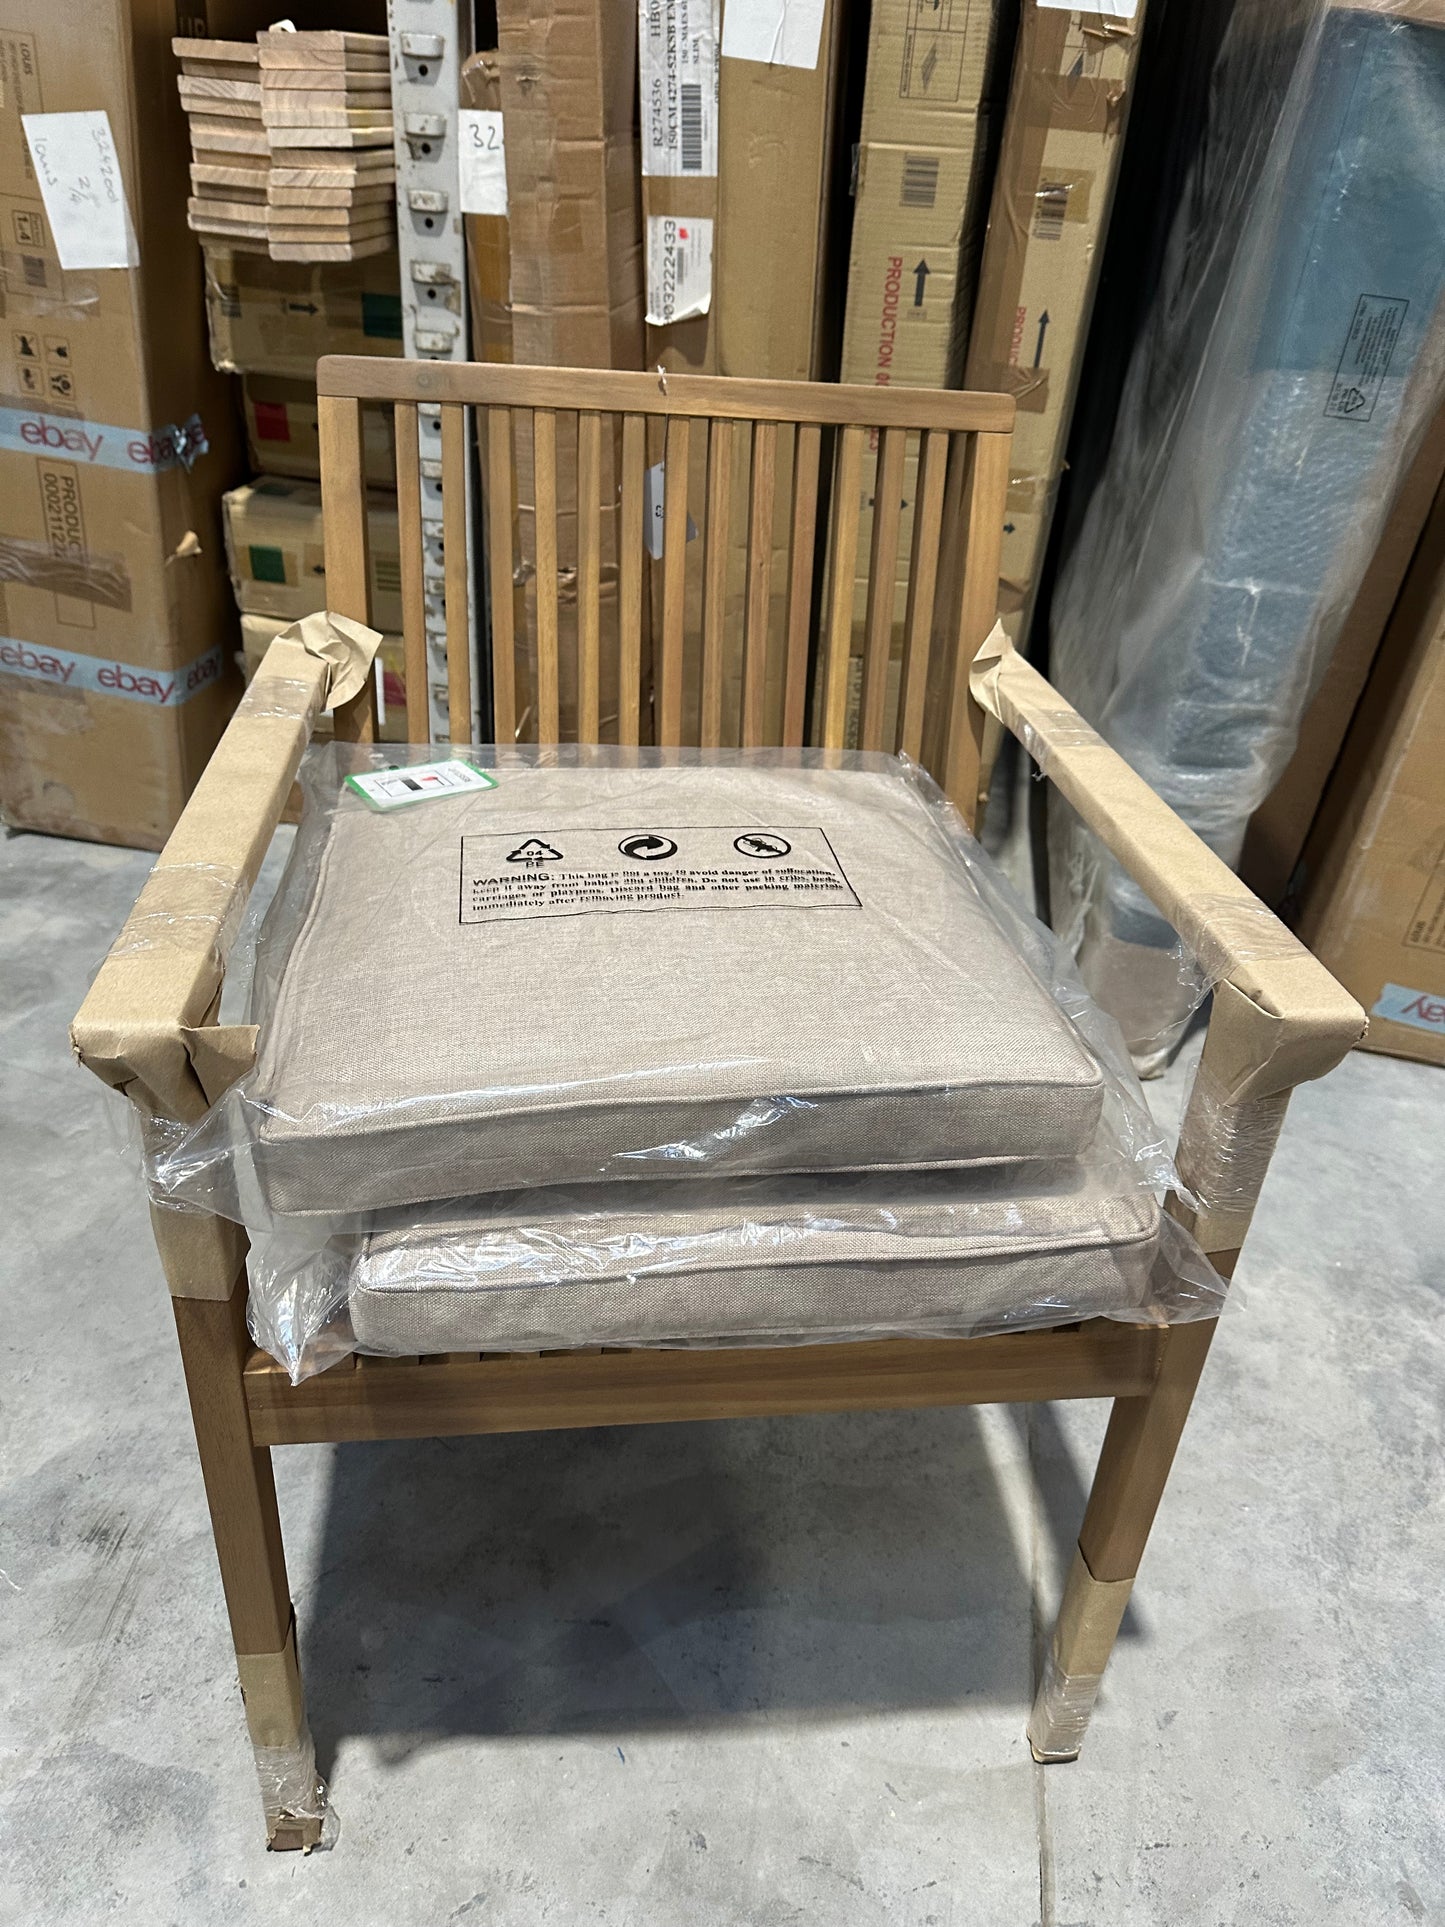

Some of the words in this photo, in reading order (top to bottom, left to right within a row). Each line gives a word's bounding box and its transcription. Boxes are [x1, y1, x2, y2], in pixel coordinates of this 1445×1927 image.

[20, 42, 33, 76] LOUIS
[652, 78, 663, 147] R274536
[667, 107, 678, 149] 150CM
[469, 124, 500, 151] 32
[877, 256, 903, 368] PRODUCTION
[21, 416, 104, 461] ebay
[1, 645, 77, 683] ebay
[98, 664, 176, 703] ebay
[472, 893, 526, 902] carriages
[550, 889, 604, 897] playpens.
[611, 885, 653, 893] Discard
[745, 883, 789, 892] packing
[793, 882, 843, 890] materials
[473, 873, 554, 886] WARNING:
[587, 872, 608, 880] bag
[721, 869, 759, 877] danger
[517, 883, 546, 891] away
[584, 879, 619, 887] babies
[472, 899, 545, 911] immediately
[549, 897, 575, 905] after
[580, 893, 634, 902] removing
[637, 891, 685, 901] product.
